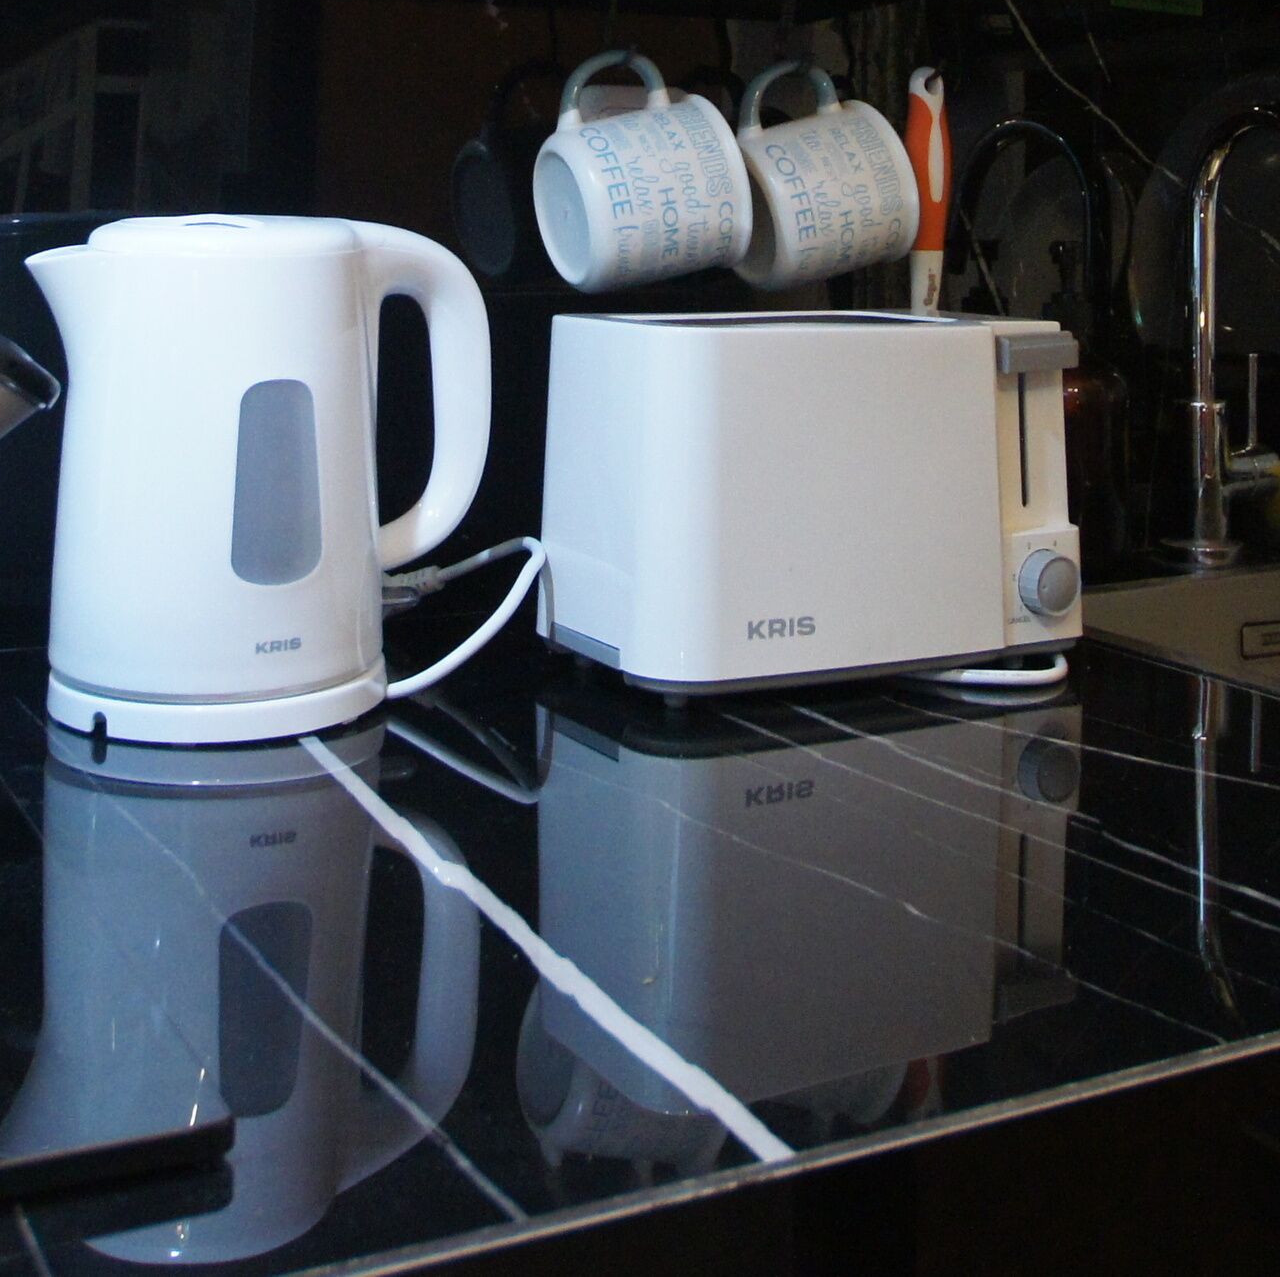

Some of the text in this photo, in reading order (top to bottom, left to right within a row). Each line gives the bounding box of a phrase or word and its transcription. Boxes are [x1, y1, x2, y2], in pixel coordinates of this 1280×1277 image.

[579, 127, 634, 220] COFFEE
[765, 144, 817, 242] COFFEE
[658, 187, 680, 259] HOME
[255, 637, 302, 655] KRIS
[747, 616, 816, 641] KRIS
